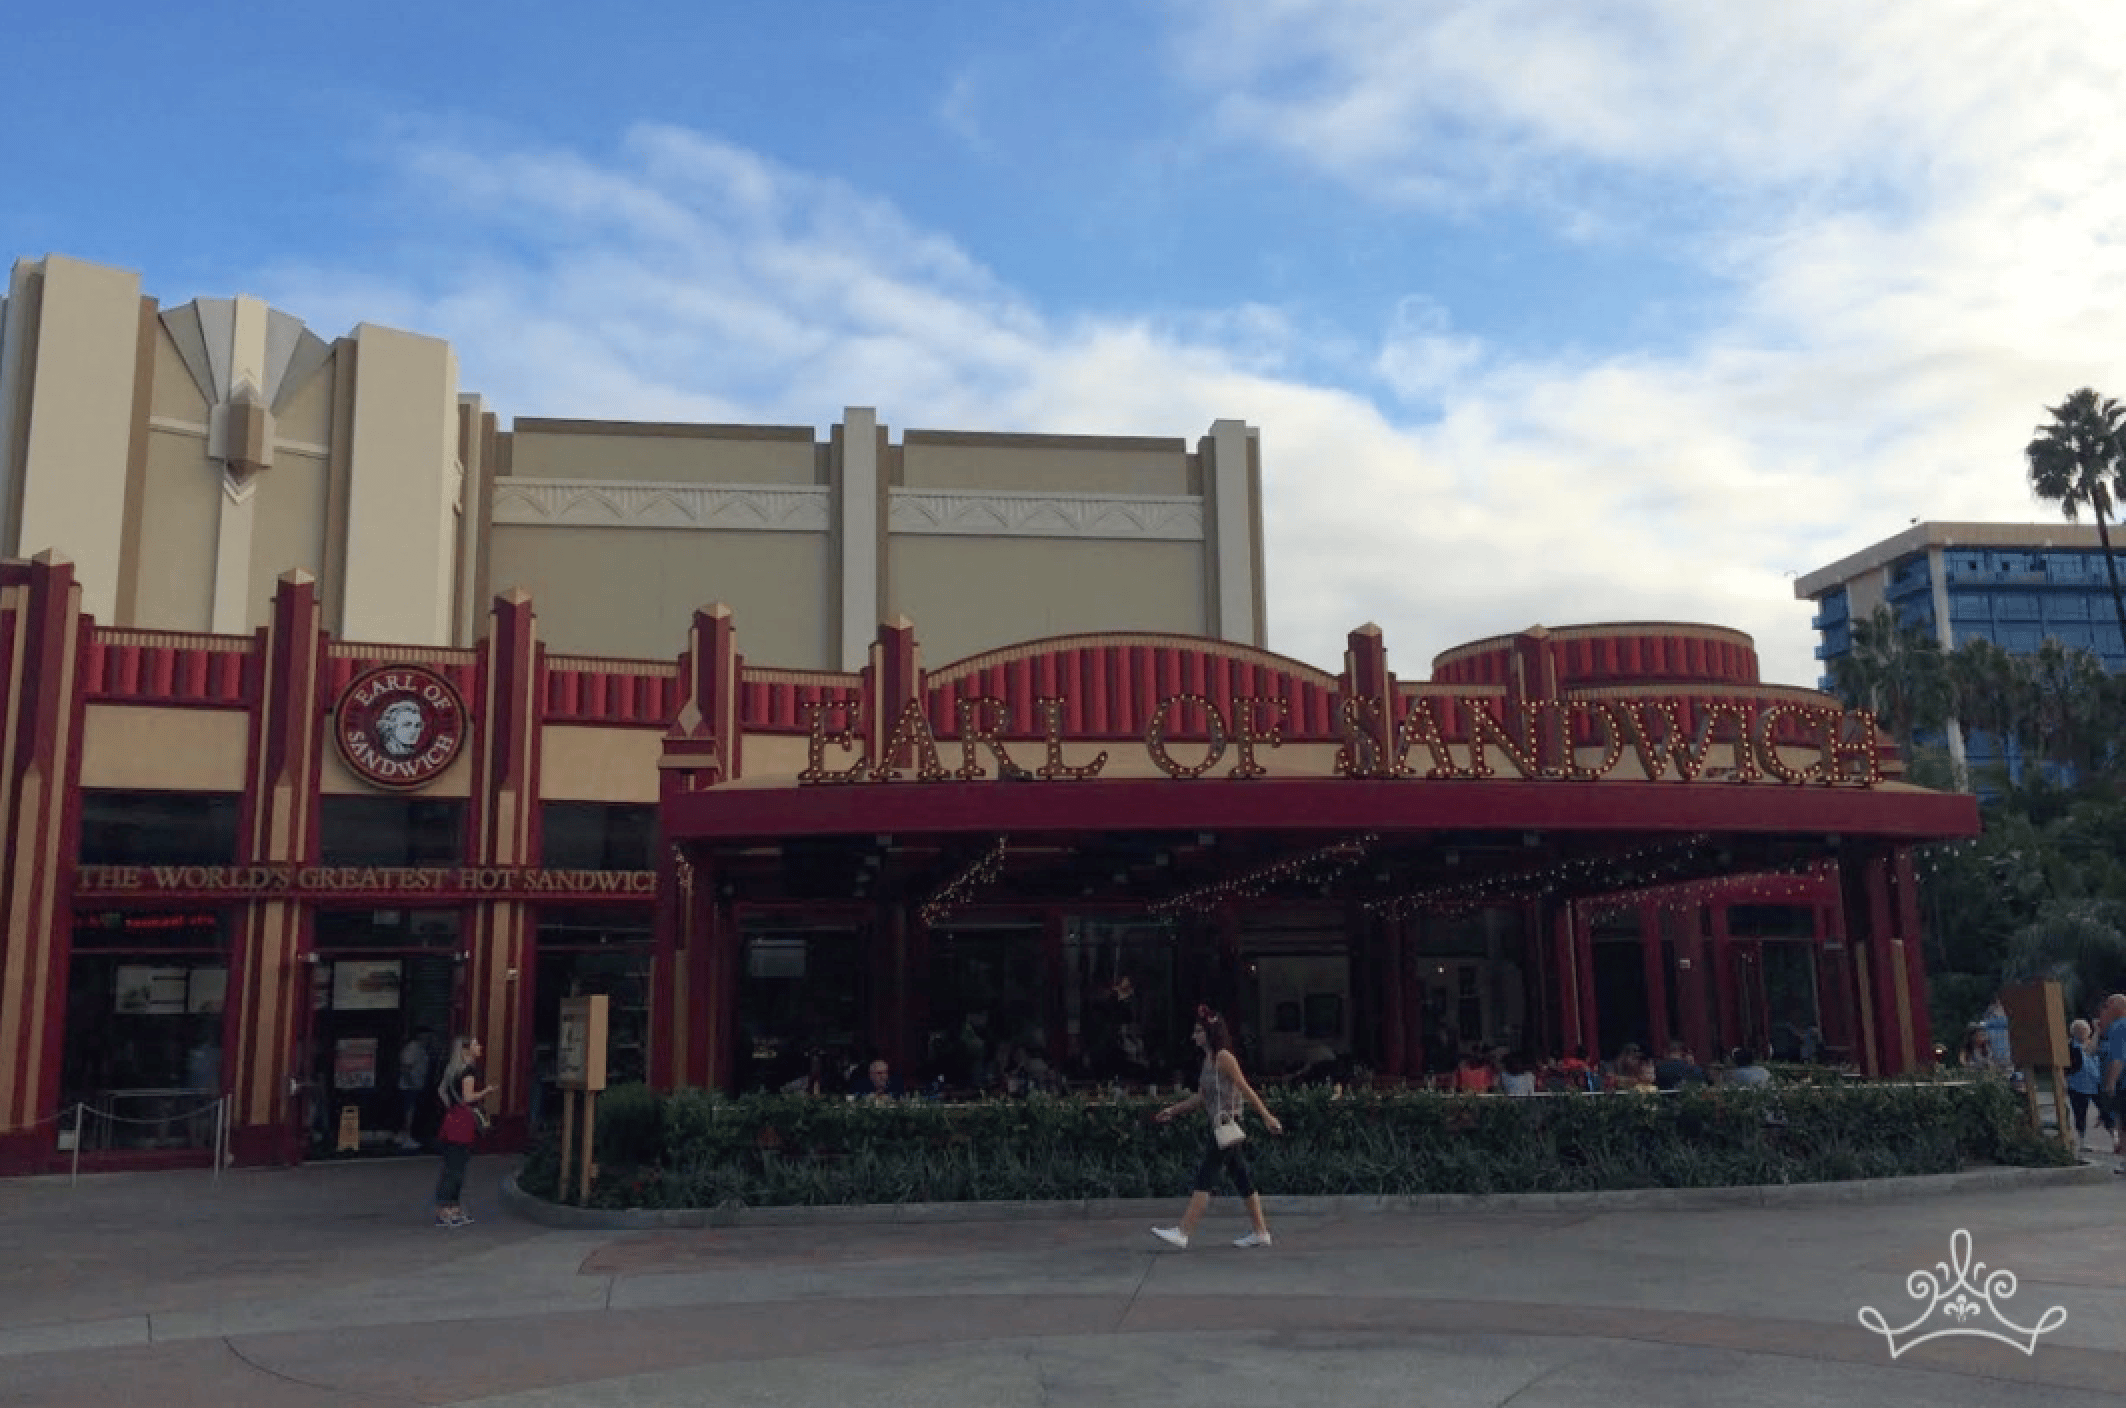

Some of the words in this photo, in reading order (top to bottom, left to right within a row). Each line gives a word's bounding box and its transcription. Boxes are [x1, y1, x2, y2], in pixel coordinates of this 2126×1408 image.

[355, 675, 417, 706] EARL
[423, 685, 452, 708] OF
[347, 731, 454, 776] SANDWICH
[798, 697, 1109, 783] EARL
[1146, 694, 1288, 781] OF
[1333, 696, 1884, 788] SANDWICH
[77, 865, 140, 888] THE
[150, 865, 291, 889] WORLD'S
[300, 866, 449, 889] GREATEST
[459, 867, 517, 890] HOT
